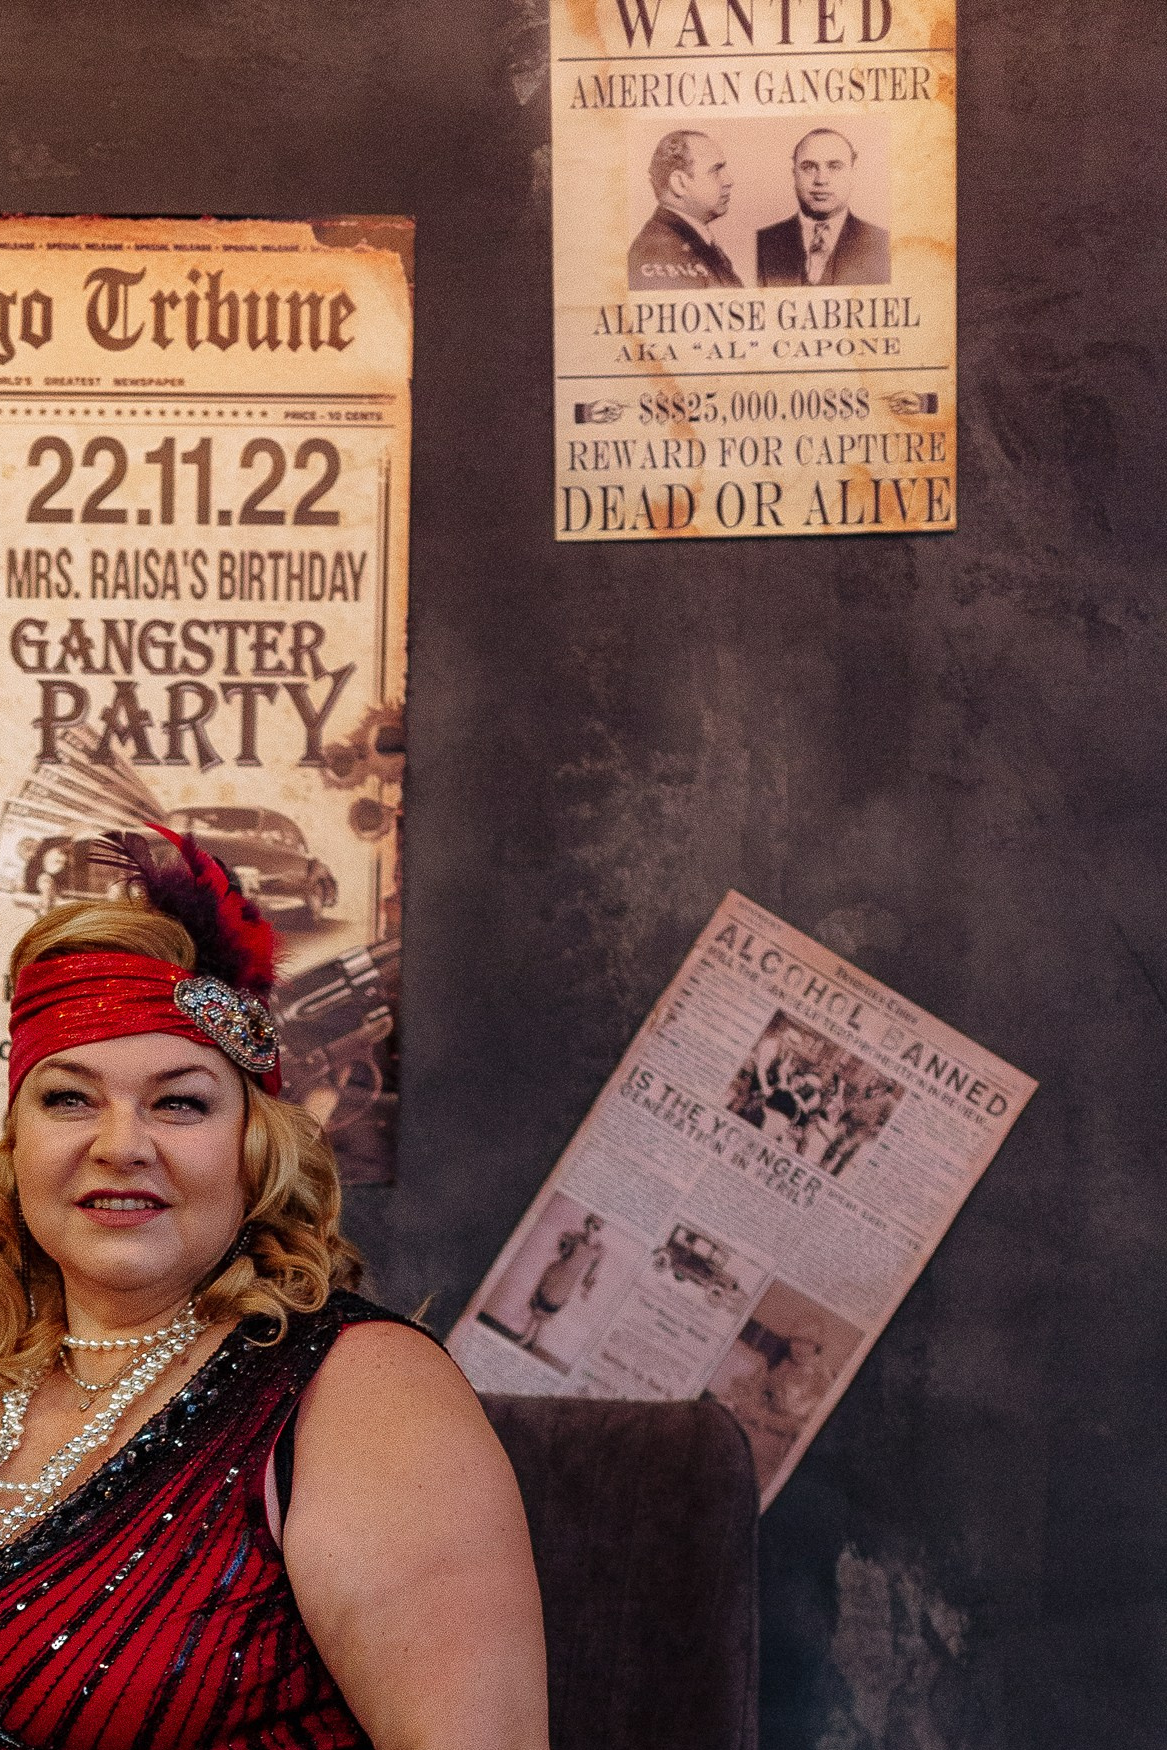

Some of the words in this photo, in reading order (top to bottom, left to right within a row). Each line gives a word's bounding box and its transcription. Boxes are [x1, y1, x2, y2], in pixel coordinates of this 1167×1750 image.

[619, 0, 893, 49] WANTED
[569, 70, 741, 110] AMERICAN
[753, 64, 931, 105] GANGSTER
[84, 265, 357, 354] Tribune
[592, 300, 766, 336] ALPHONSE
[776, 295, 920, 331] GABRIEL
[614, 343, 678, 363] AKA
[772, 336, 901, 359] CAPONE
[43, 376, 101, 387] GREATEST
[112, 376, 186, 387] NEWSPAPER
[567, 436, 707, 472] REWARD
[717, 435, 783, 468] FOR
[794, 430, 947, 466] CAPTURE
[25, 435, 342, 527] 22.11.22
[559, 482, 696, 533] DEAD
[715, 480, 786, 528] OR
[801, 476, 953, 526] ALIVE
[7, 547, 80, 601] MRS.
[90, 549, 209, 601] RAISA'S
[218, 550, 368, 602] BIRTHDAY
[8, 618, 328, 683] GANGSTER
[31, 661, 356, 772] PARTY
[711, 919, 873, 1032] ALCOHOL
[877, 1023, 1015, 1122] BANNED
[624, 1063, 656, 1093] IS
[655, 1082, 707, 1125] THE
